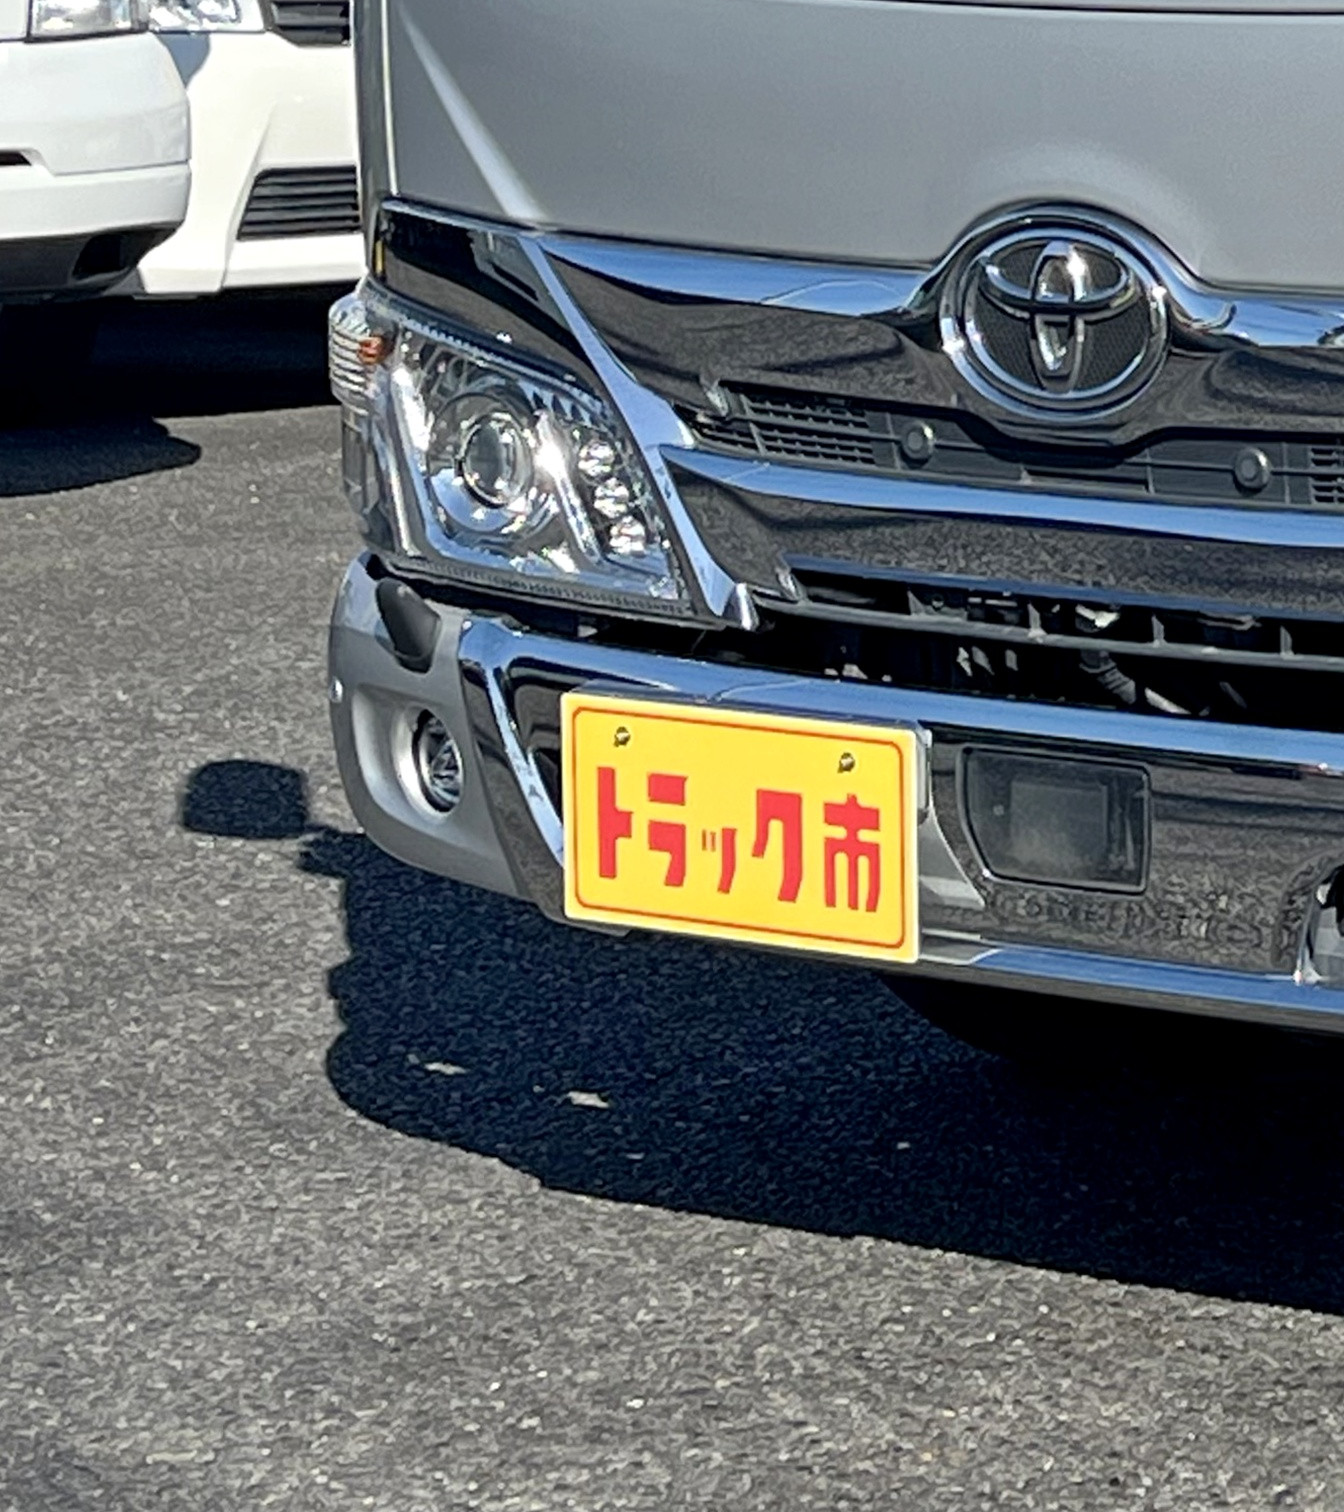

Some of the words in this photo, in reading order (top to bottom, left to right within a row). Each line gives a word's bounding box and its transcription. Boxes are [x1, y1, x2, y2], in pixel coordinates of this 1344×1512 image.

[597, 765, 881, 913] トラック市
